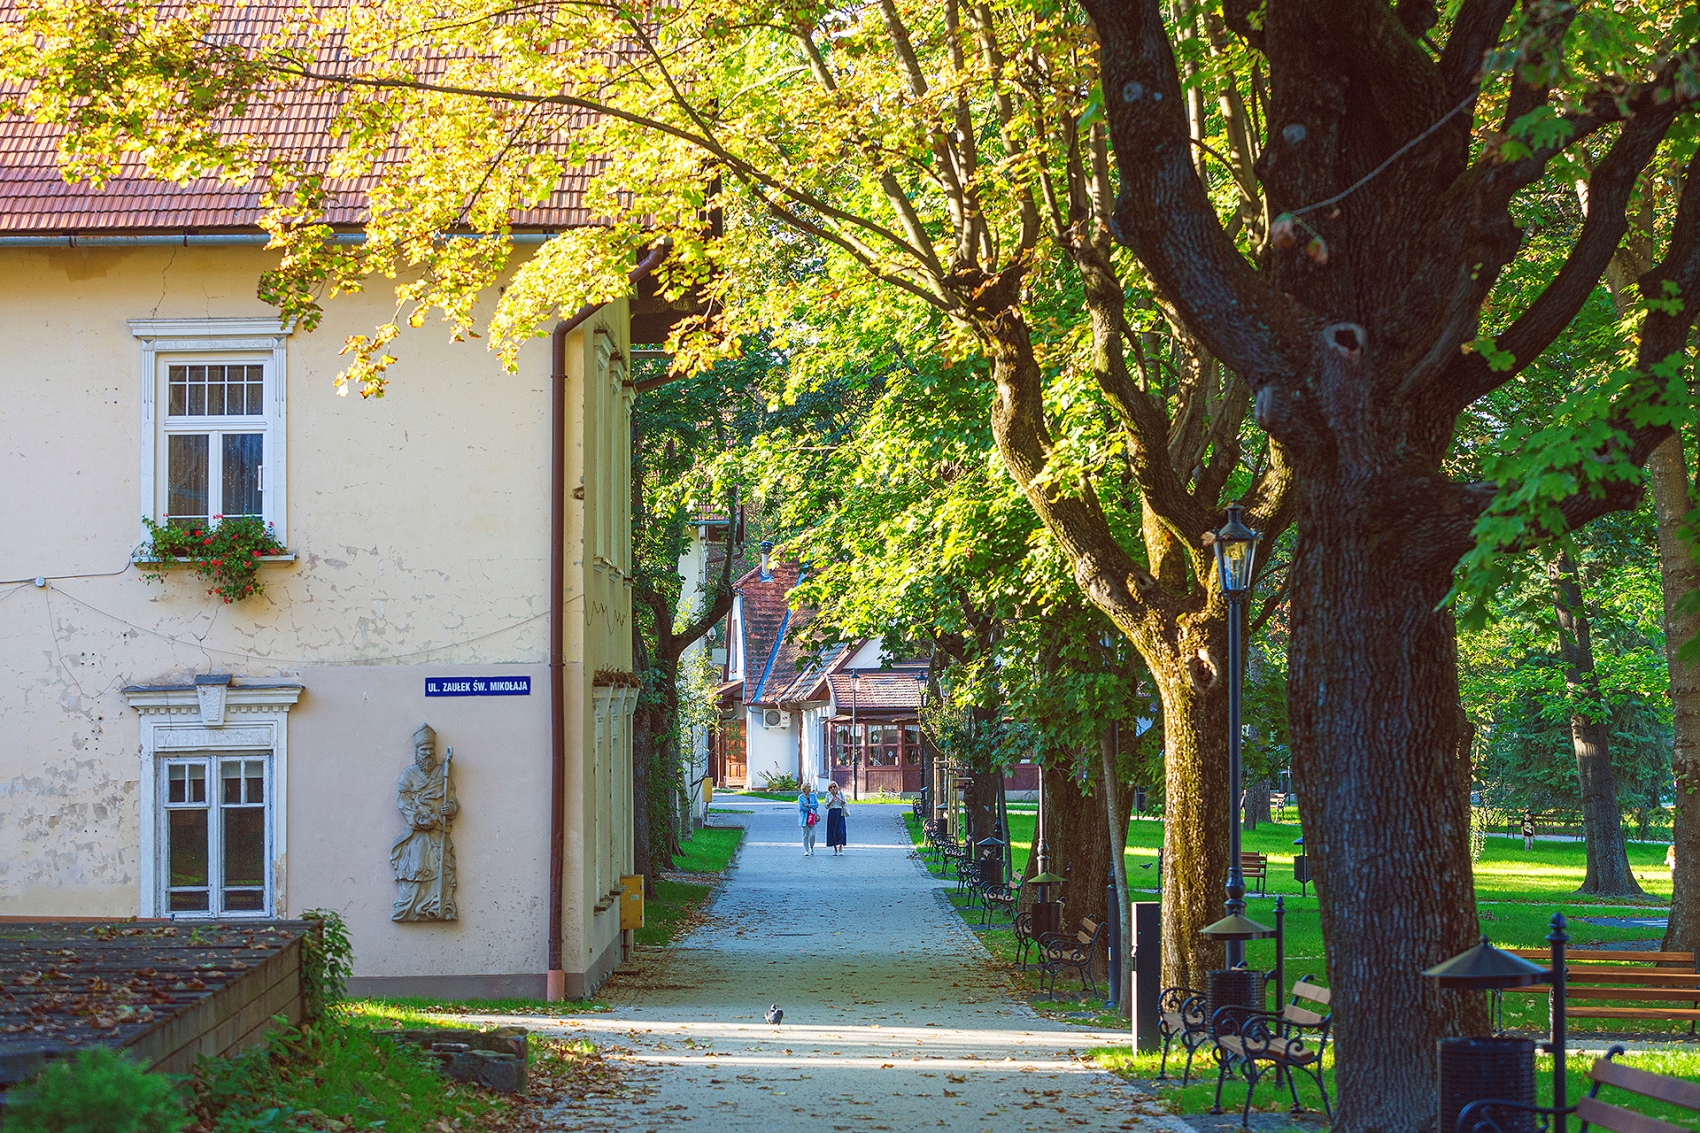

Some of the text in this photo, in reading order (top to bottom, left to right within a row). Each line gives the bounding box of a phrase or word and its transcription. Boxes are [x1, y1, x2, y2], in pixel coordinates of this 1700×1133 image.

[428, 680, 528, 692] UL. ZAUŁEK ŚW. MIKOŁAJA
